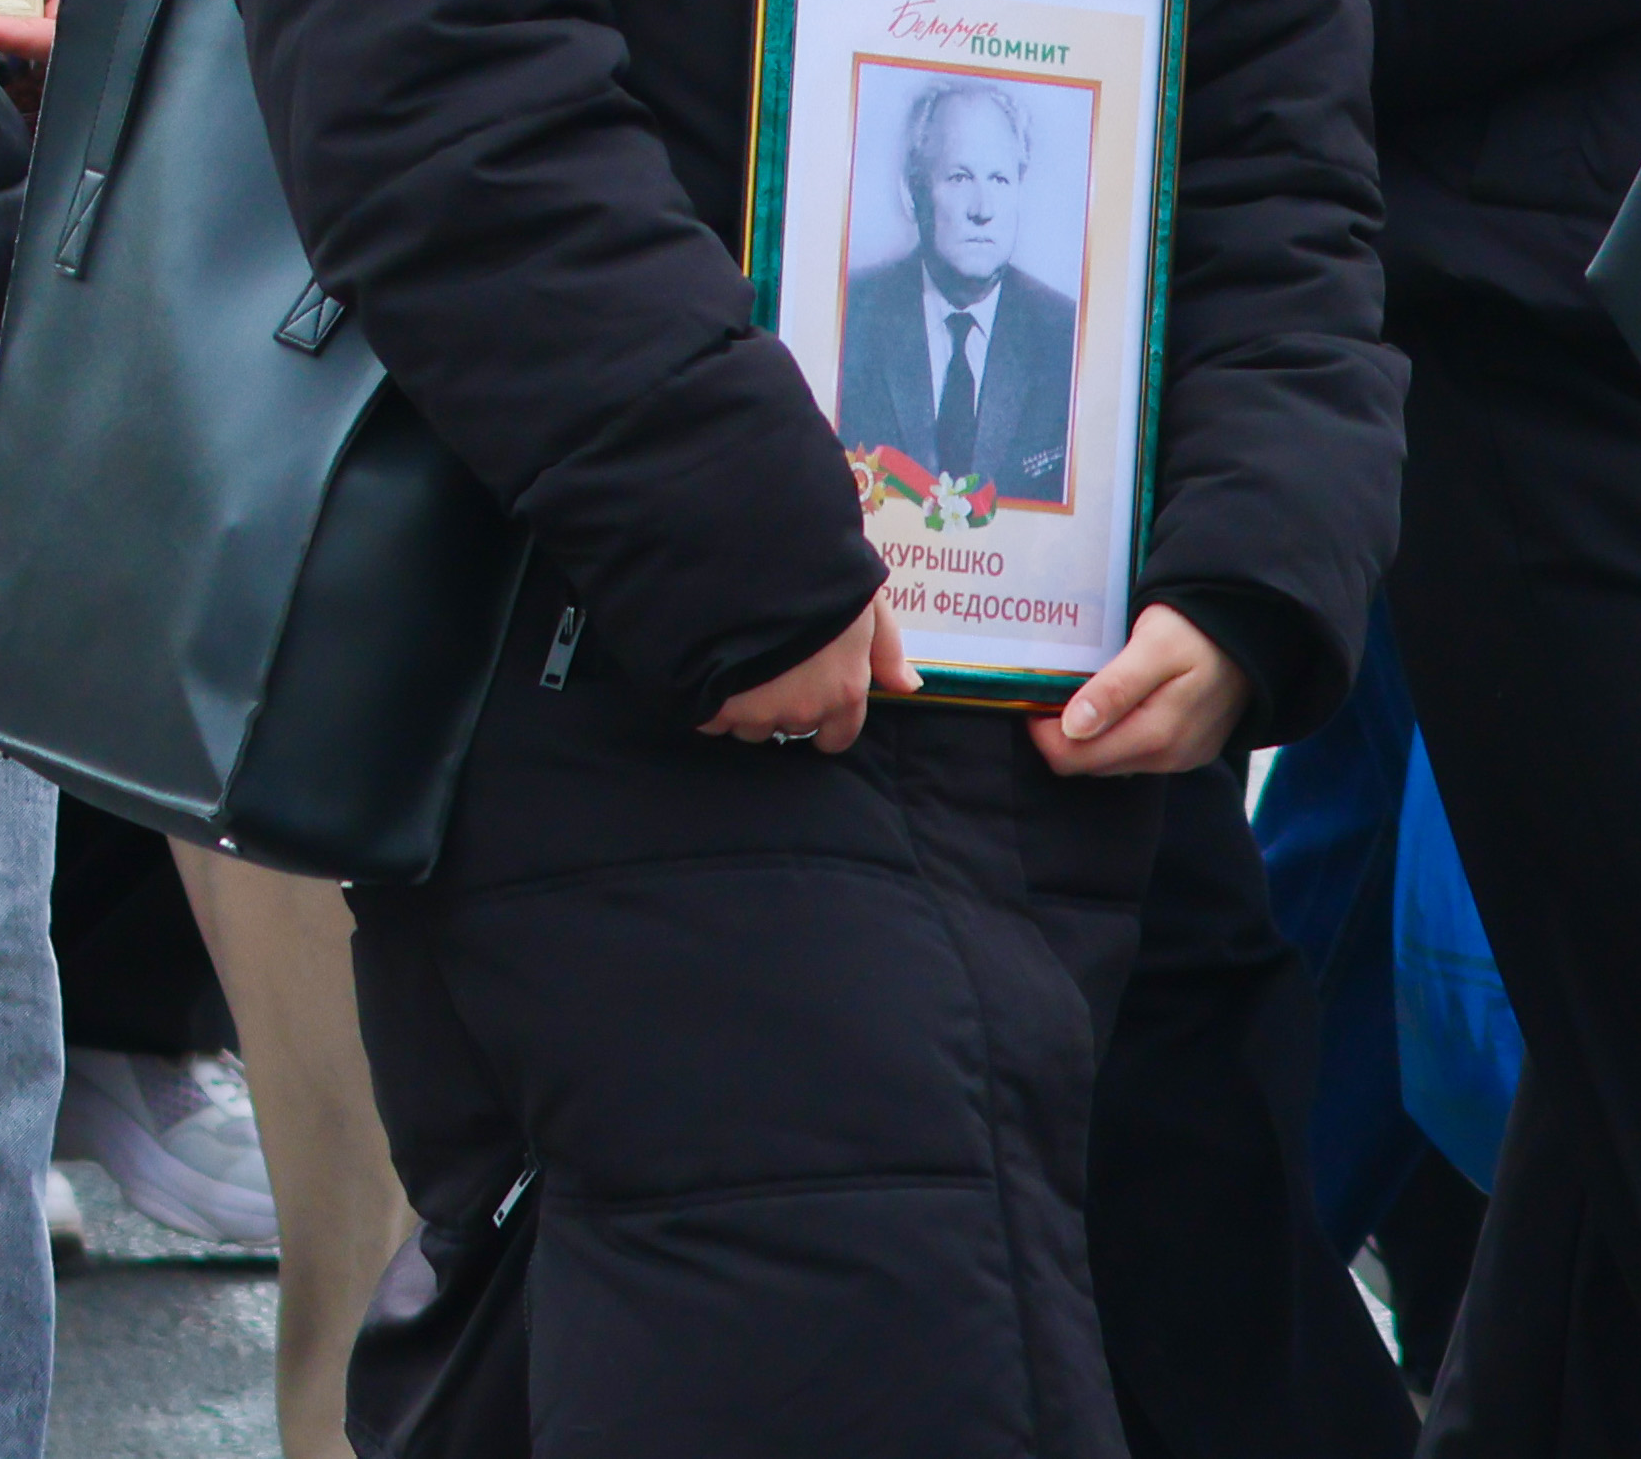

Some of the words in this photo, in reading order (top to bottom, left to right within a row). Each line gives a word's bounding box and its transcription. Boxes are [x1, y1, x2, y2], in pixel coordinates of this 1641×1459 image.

[888, 0, 999, 48] Беларусь
[970, 35, 1070, 65] ПОМНИТ
[881, 542, 1005, 577] КУРЫШКО
[933, 589, 1079, 627] ФЕДОСОВИЧ
